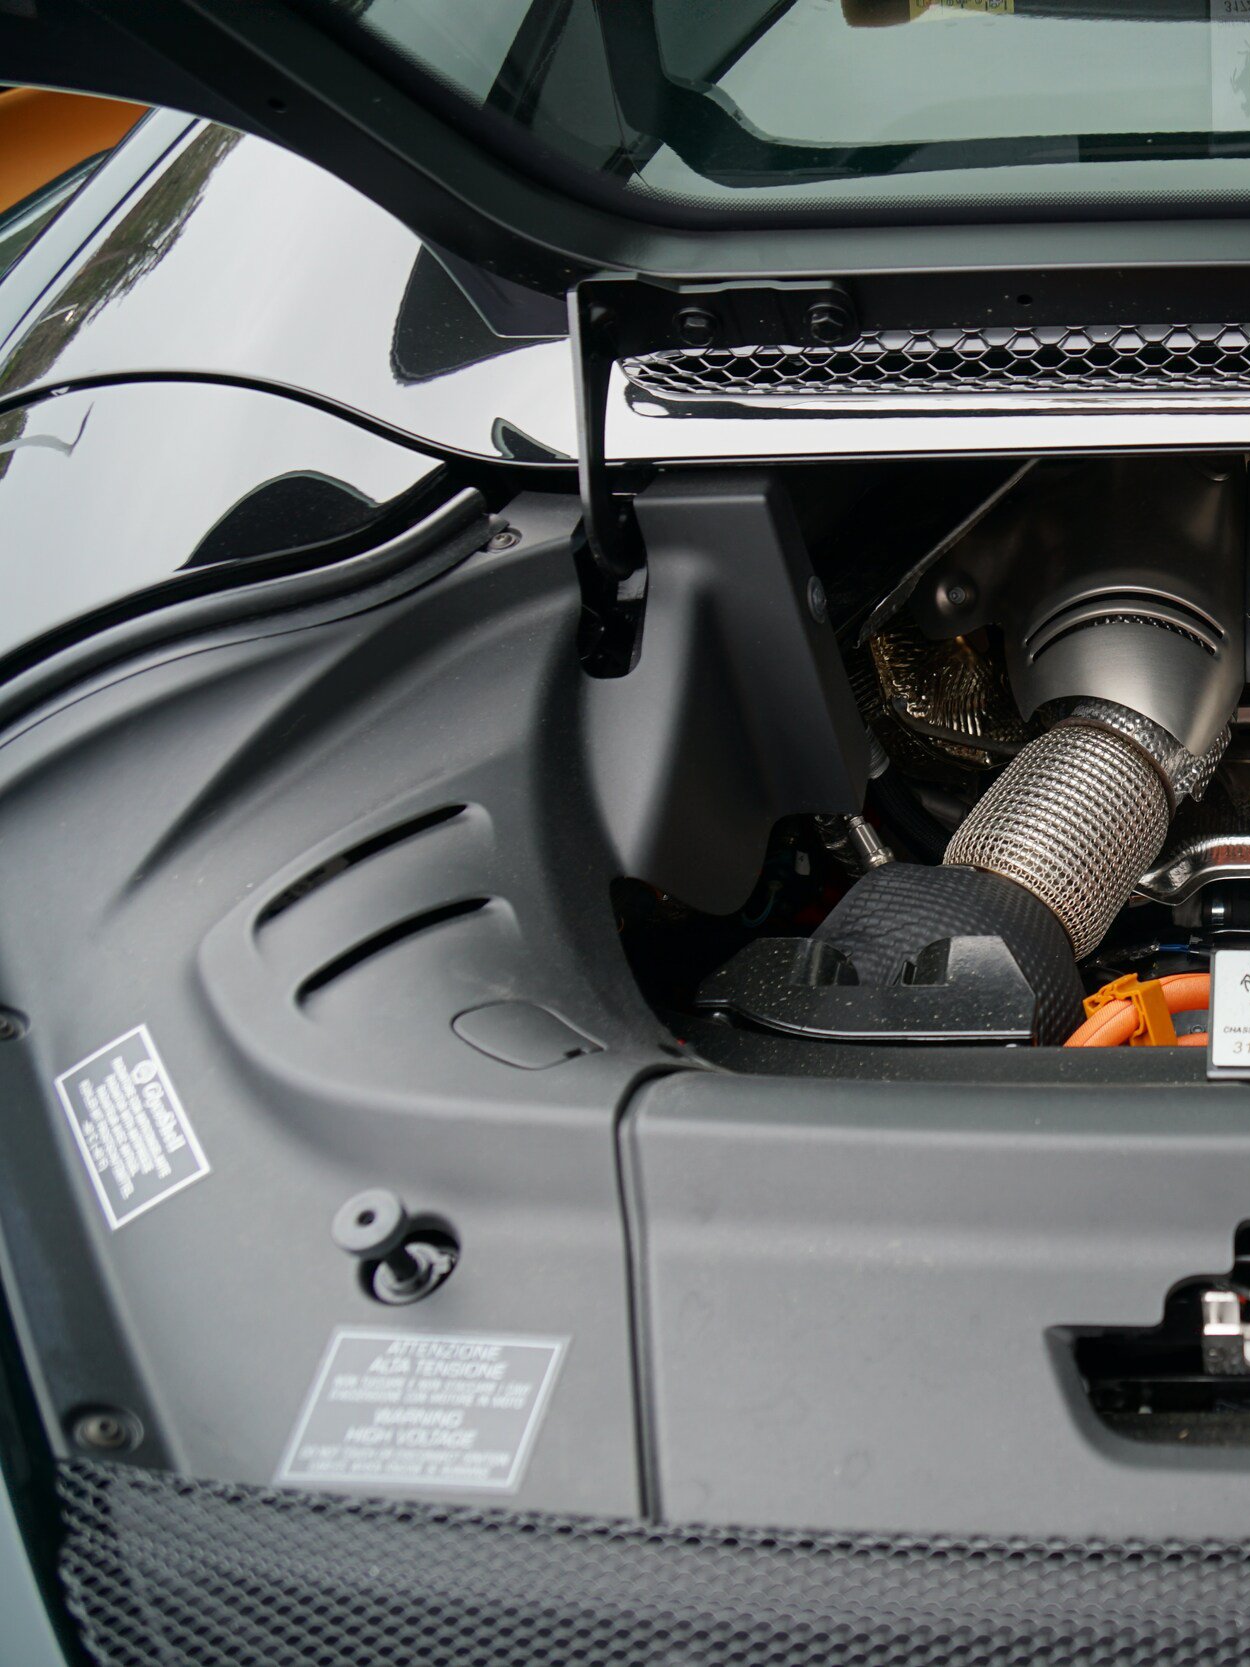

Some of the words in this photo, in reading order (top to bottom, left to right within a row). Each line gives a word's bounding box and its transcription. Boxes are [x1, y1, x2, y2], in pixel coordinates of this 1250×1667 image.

[385, 1340, 501, 1361] ATTENZIONE
[368, 1356, 411, 1374] ALTA
[415, 1359, 509, 1379] TENSIONE
[373, 1407, 465, 1429] WARNING
[344, 1426, 394, 1445] HIGH
[396, 1428, 478, 1449] VOLTAGE
